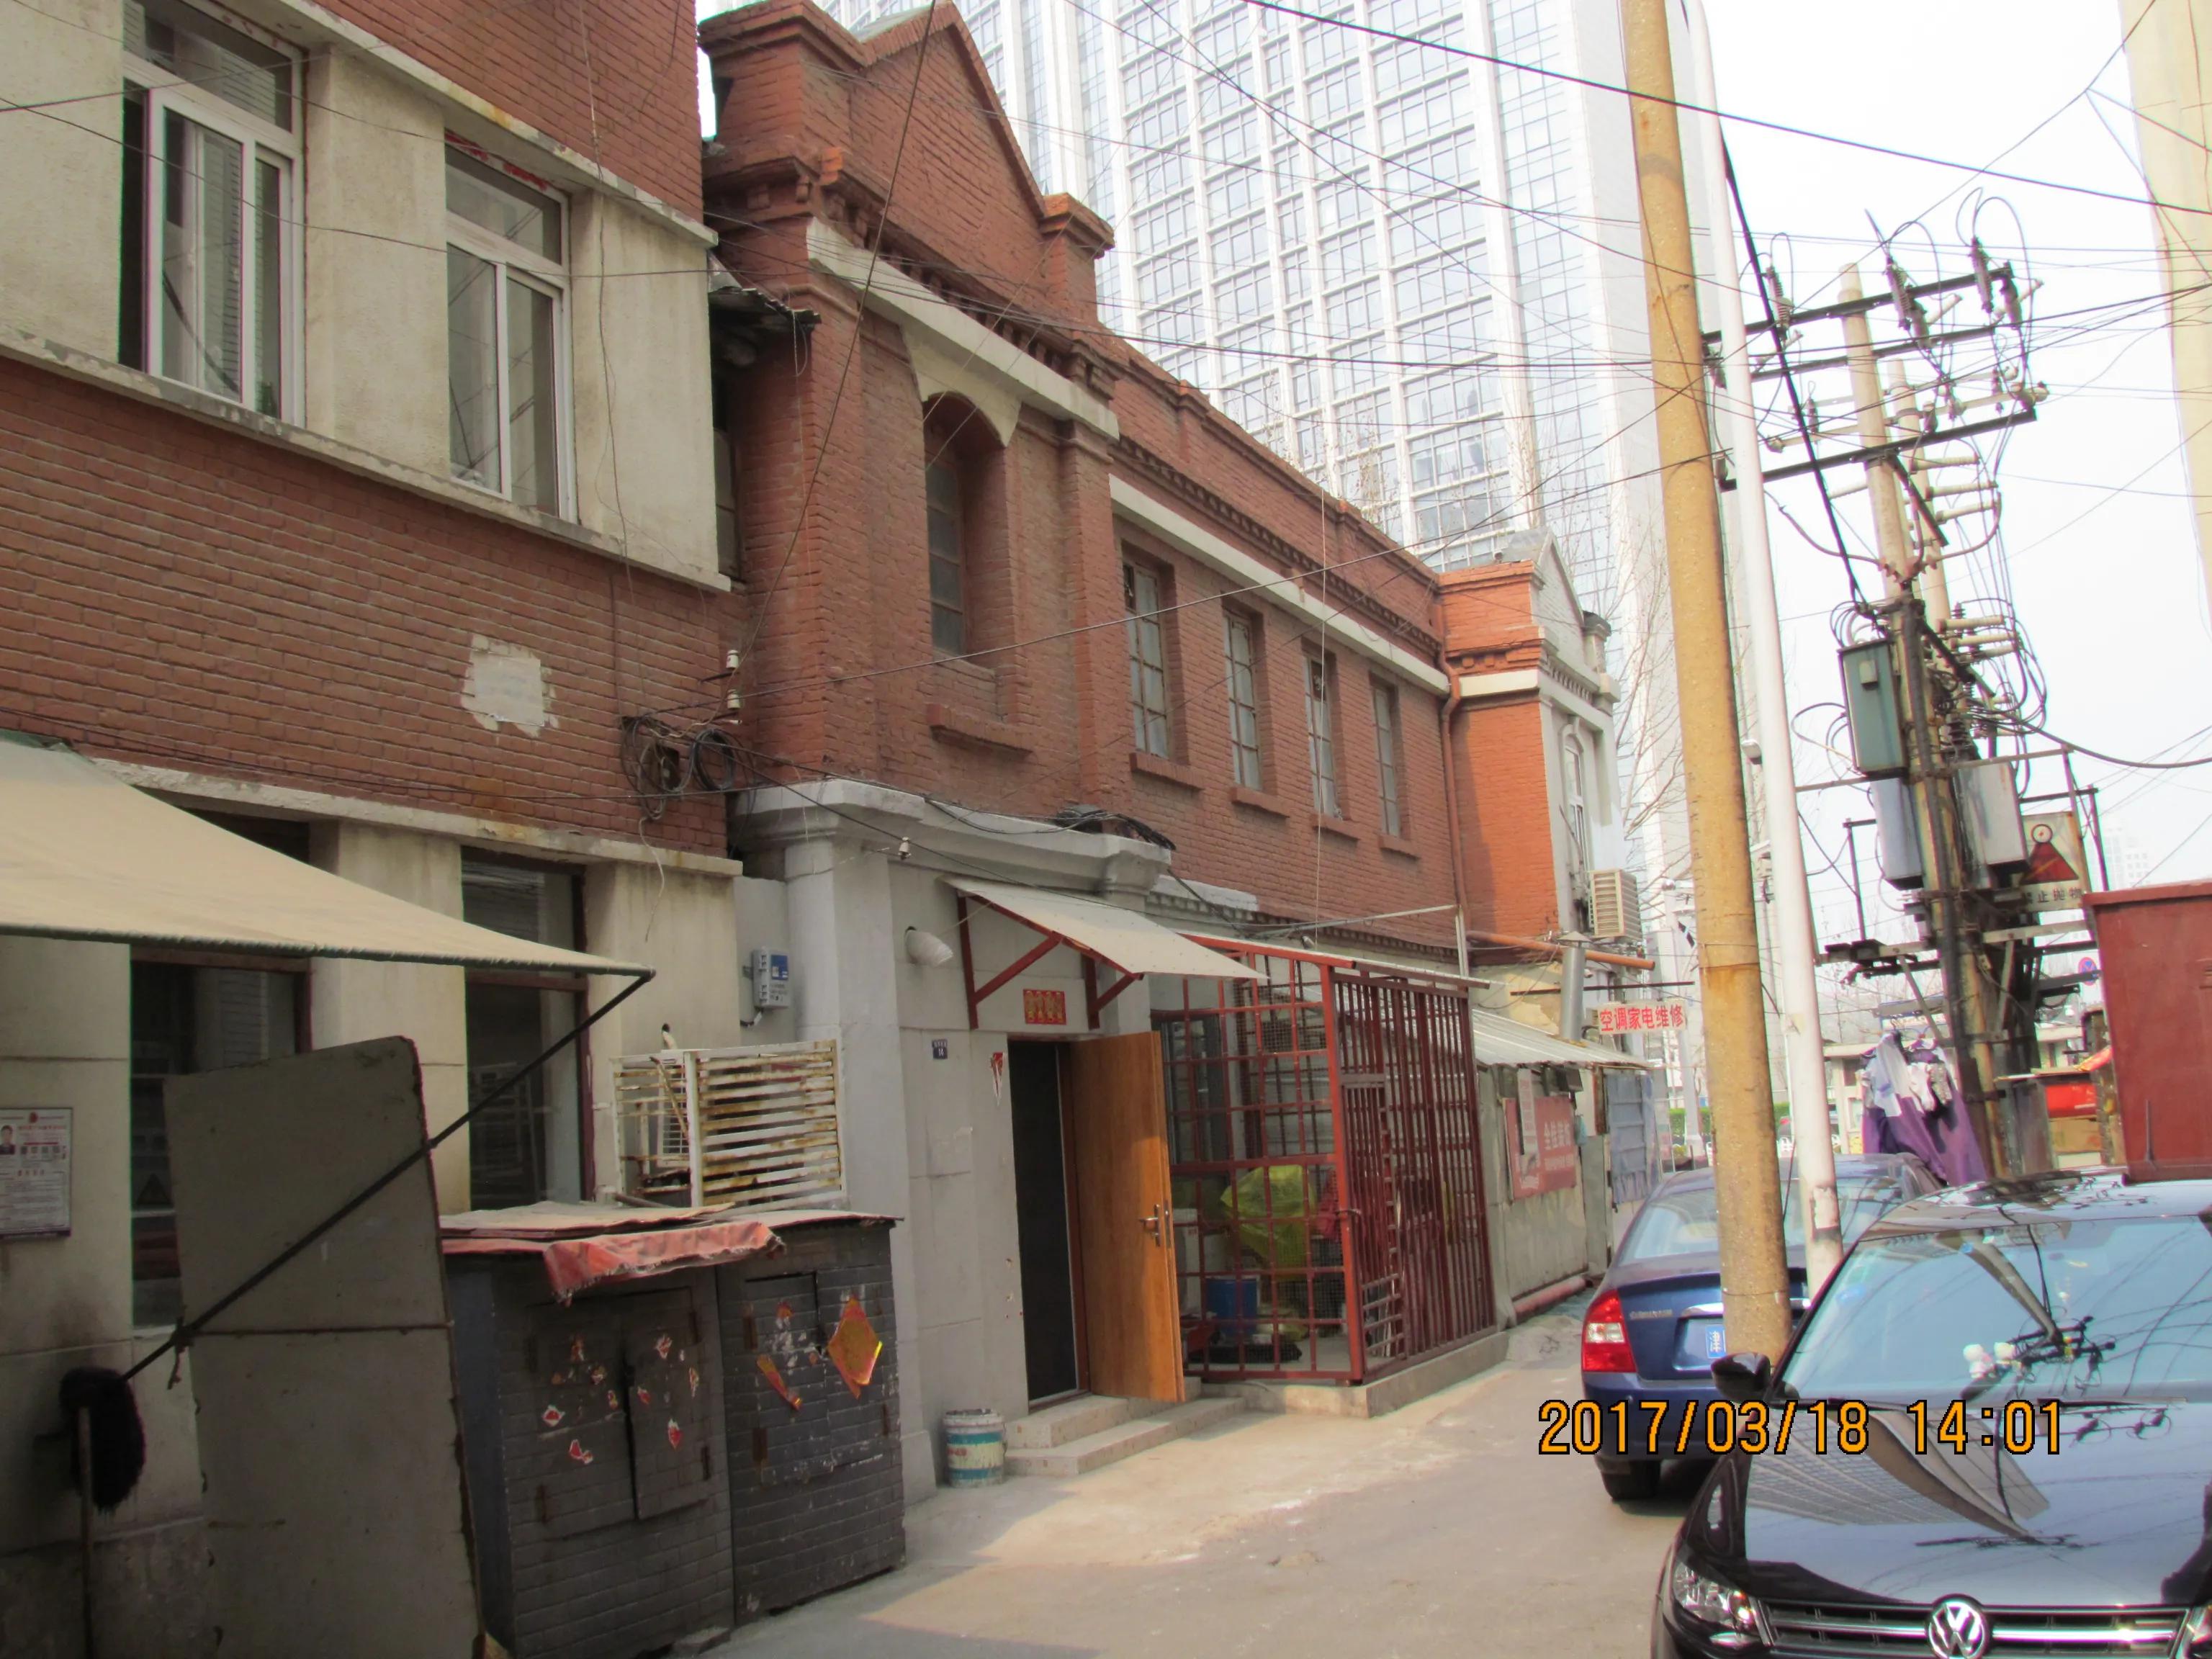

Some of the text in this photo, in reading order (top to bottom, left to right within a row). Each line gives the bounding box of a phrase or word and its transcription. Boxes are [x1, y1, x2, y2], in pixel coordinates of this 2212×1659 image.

[1599, 1004, 1684, 1032] 空调家电维修
